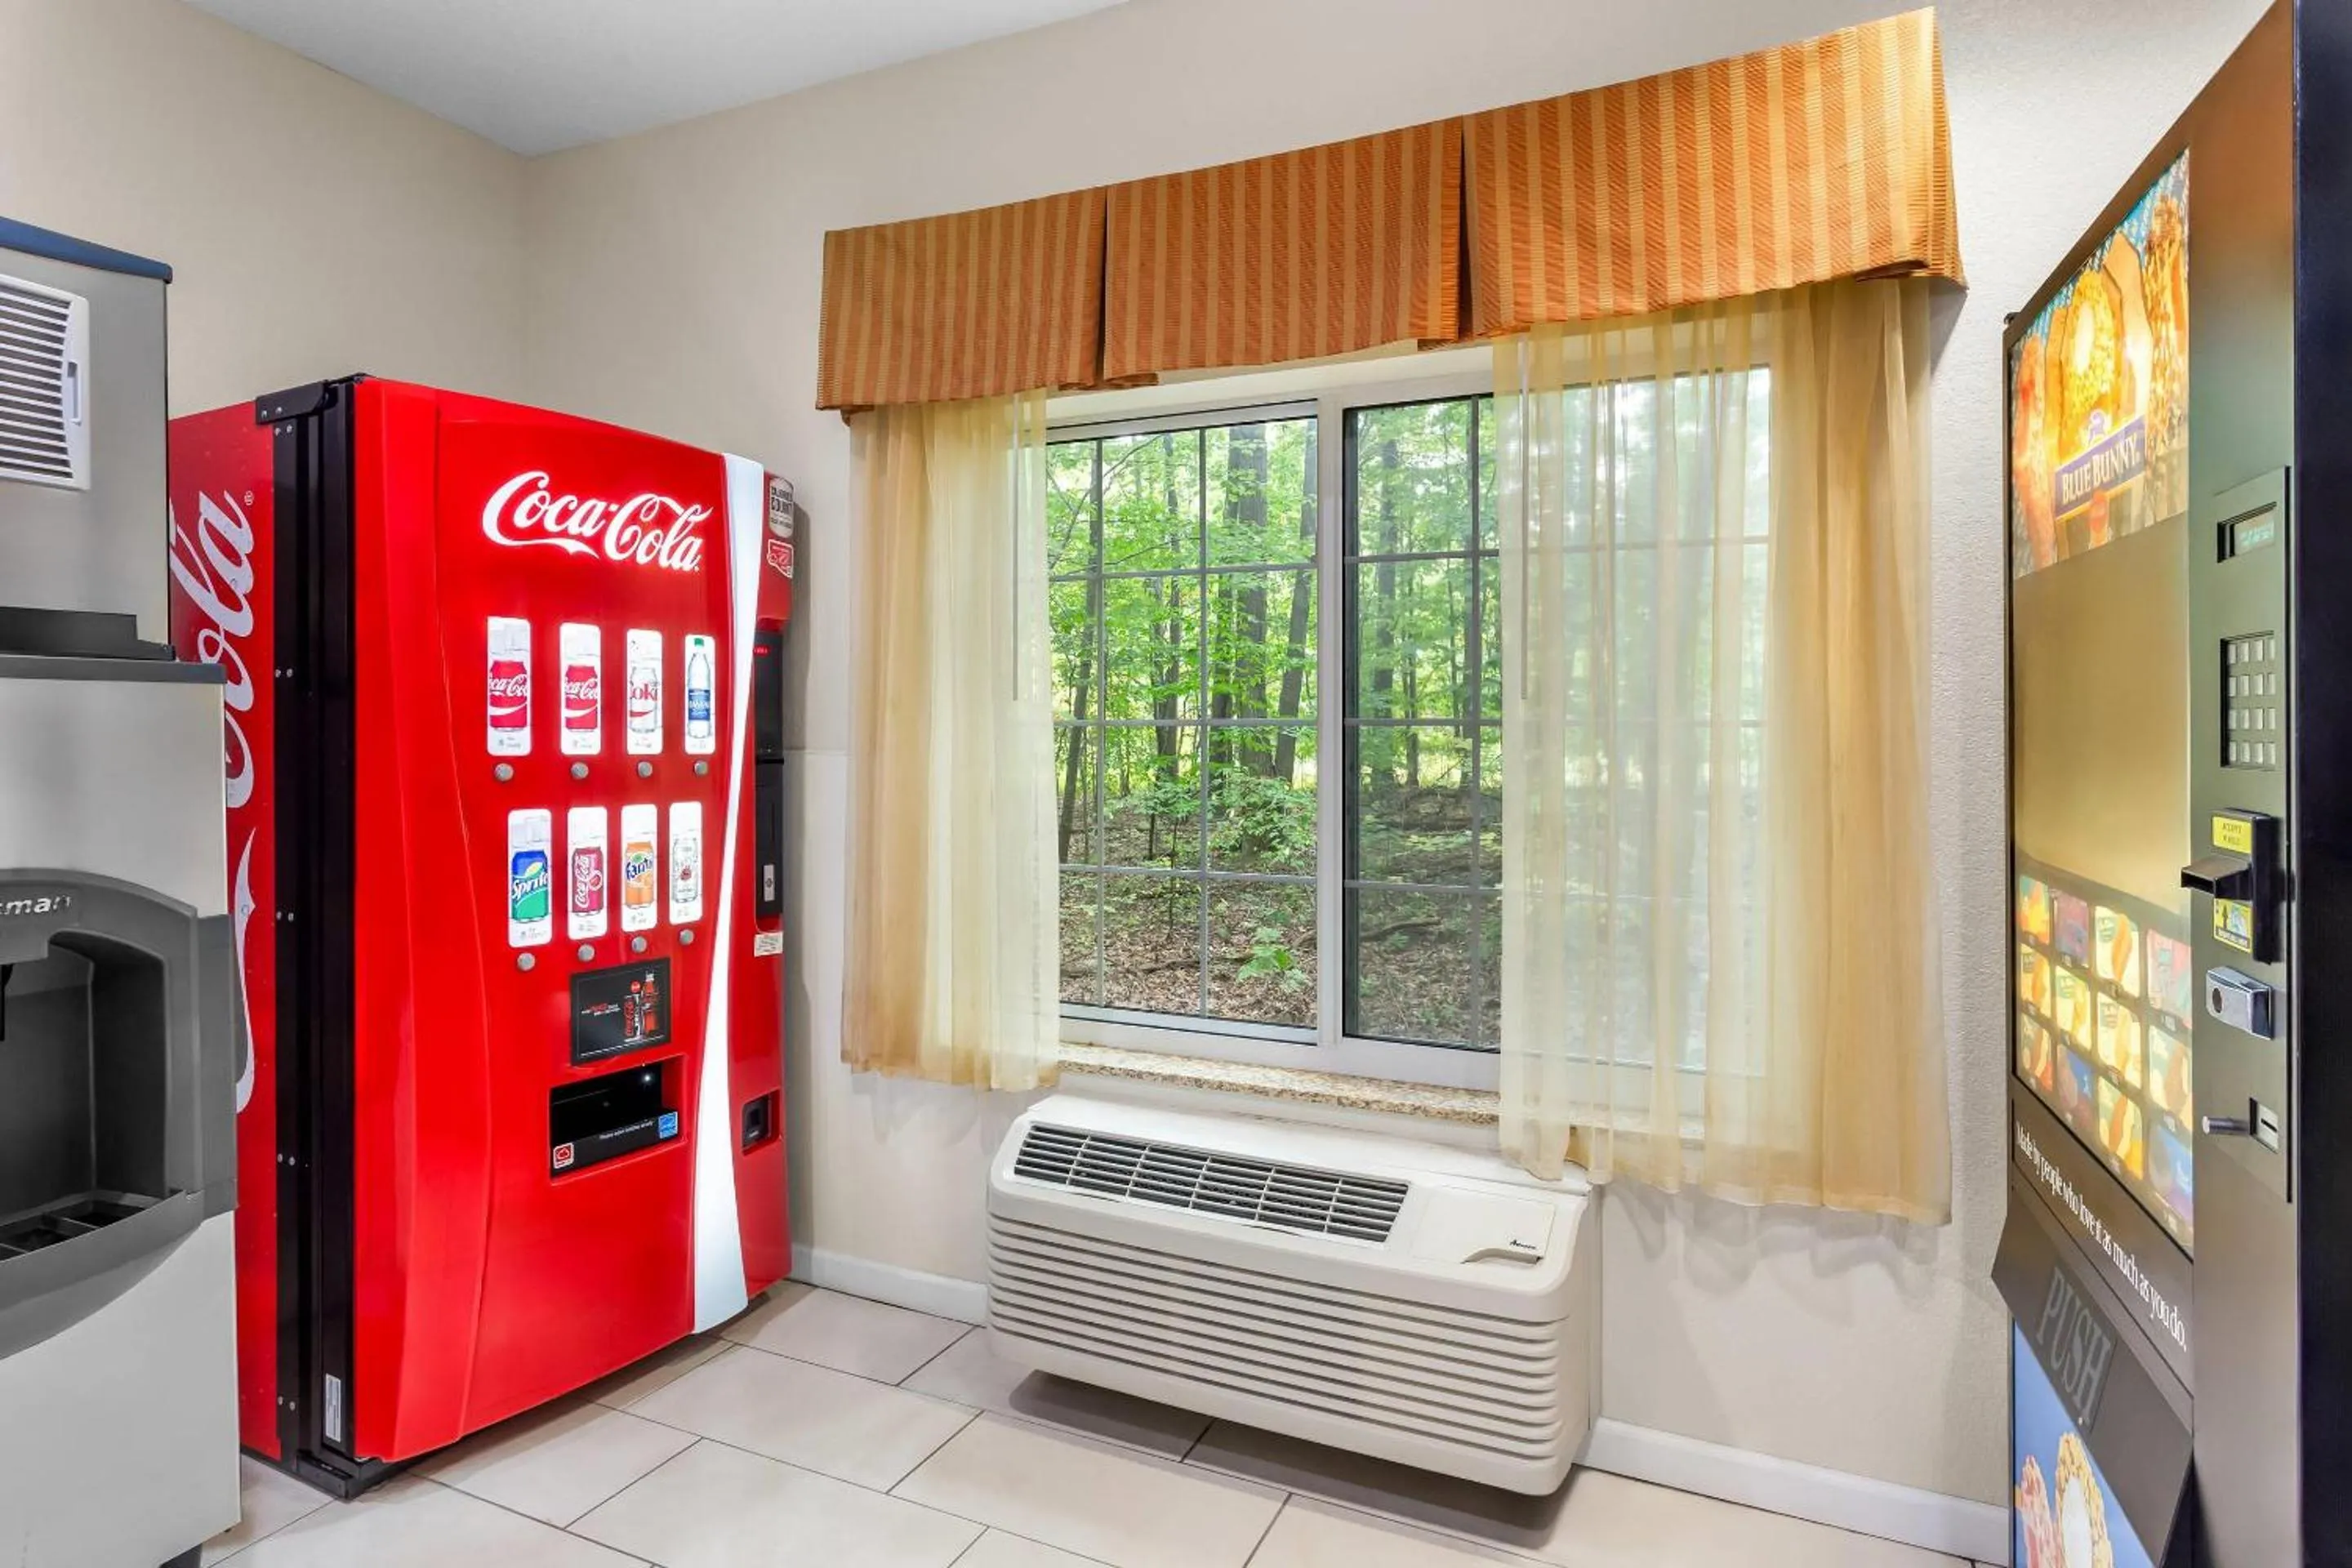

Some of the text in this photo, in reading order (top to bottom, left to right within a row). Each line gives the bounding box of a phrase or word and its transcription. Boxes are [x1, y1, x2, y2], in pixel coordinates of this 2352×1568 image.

[482, 470, 714, 572] Coca-Cola
[2062, 432, 2137, 506] BLUE BUNNY
[2041, 1156, 2062, 1196] people
[2063, 1182, 2079, 1215] who
[2102, 1230, 2112, 1256] as
[2113, 1241, 2139, 1290] much
[2140, 1273, 2149, 1303] as
[2150, 1286, 2169, 1329] you
[2036, 1267, 2111, 1426] PUSH
